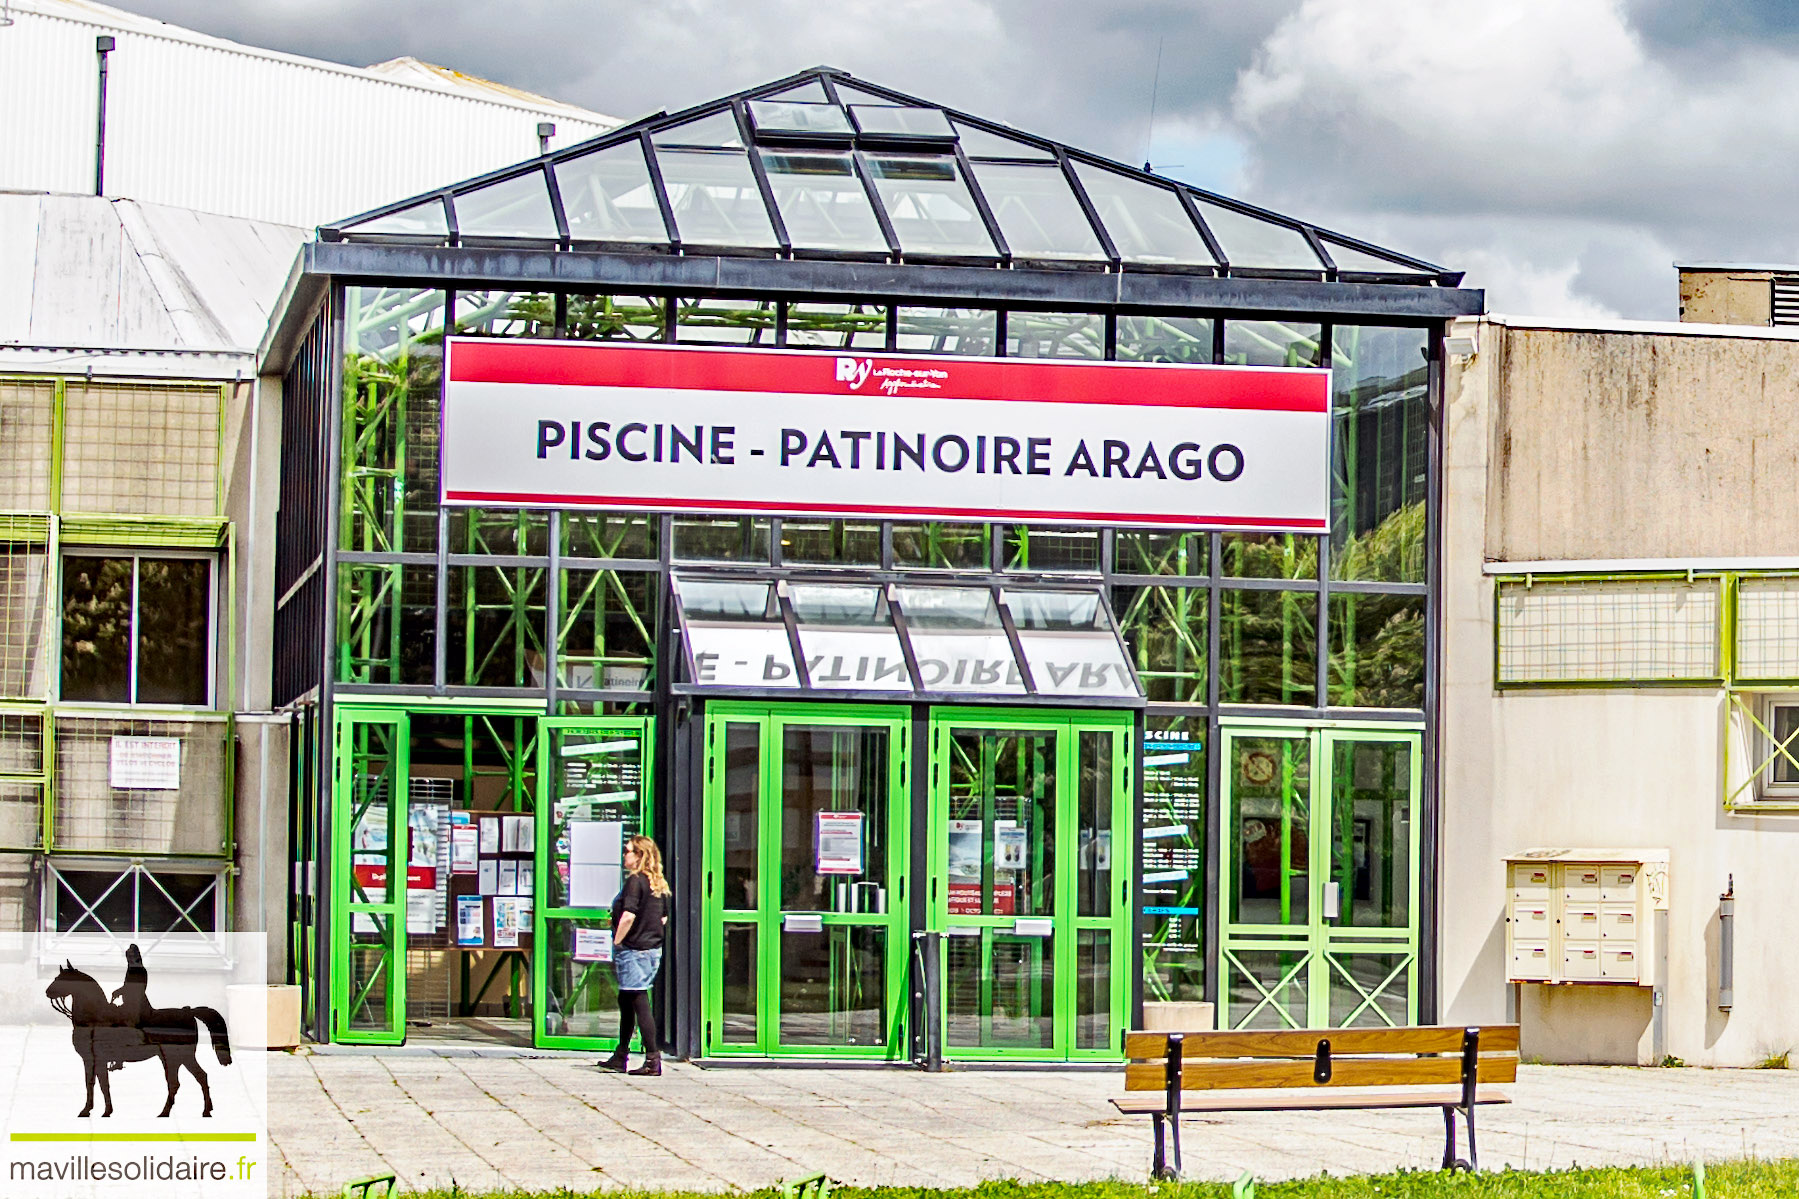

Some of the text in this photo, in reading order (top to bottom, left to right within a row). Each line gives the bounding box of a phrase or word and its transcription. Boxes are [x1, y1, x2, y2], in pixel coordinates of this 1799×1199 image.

[536, 419, 736, 465] PISCINE
[780, 427, 1052, 476] PATINOIRE
[1064, 438, 1245, 482] ARAGO
[1143, 730, 1190, 741] SCINE
